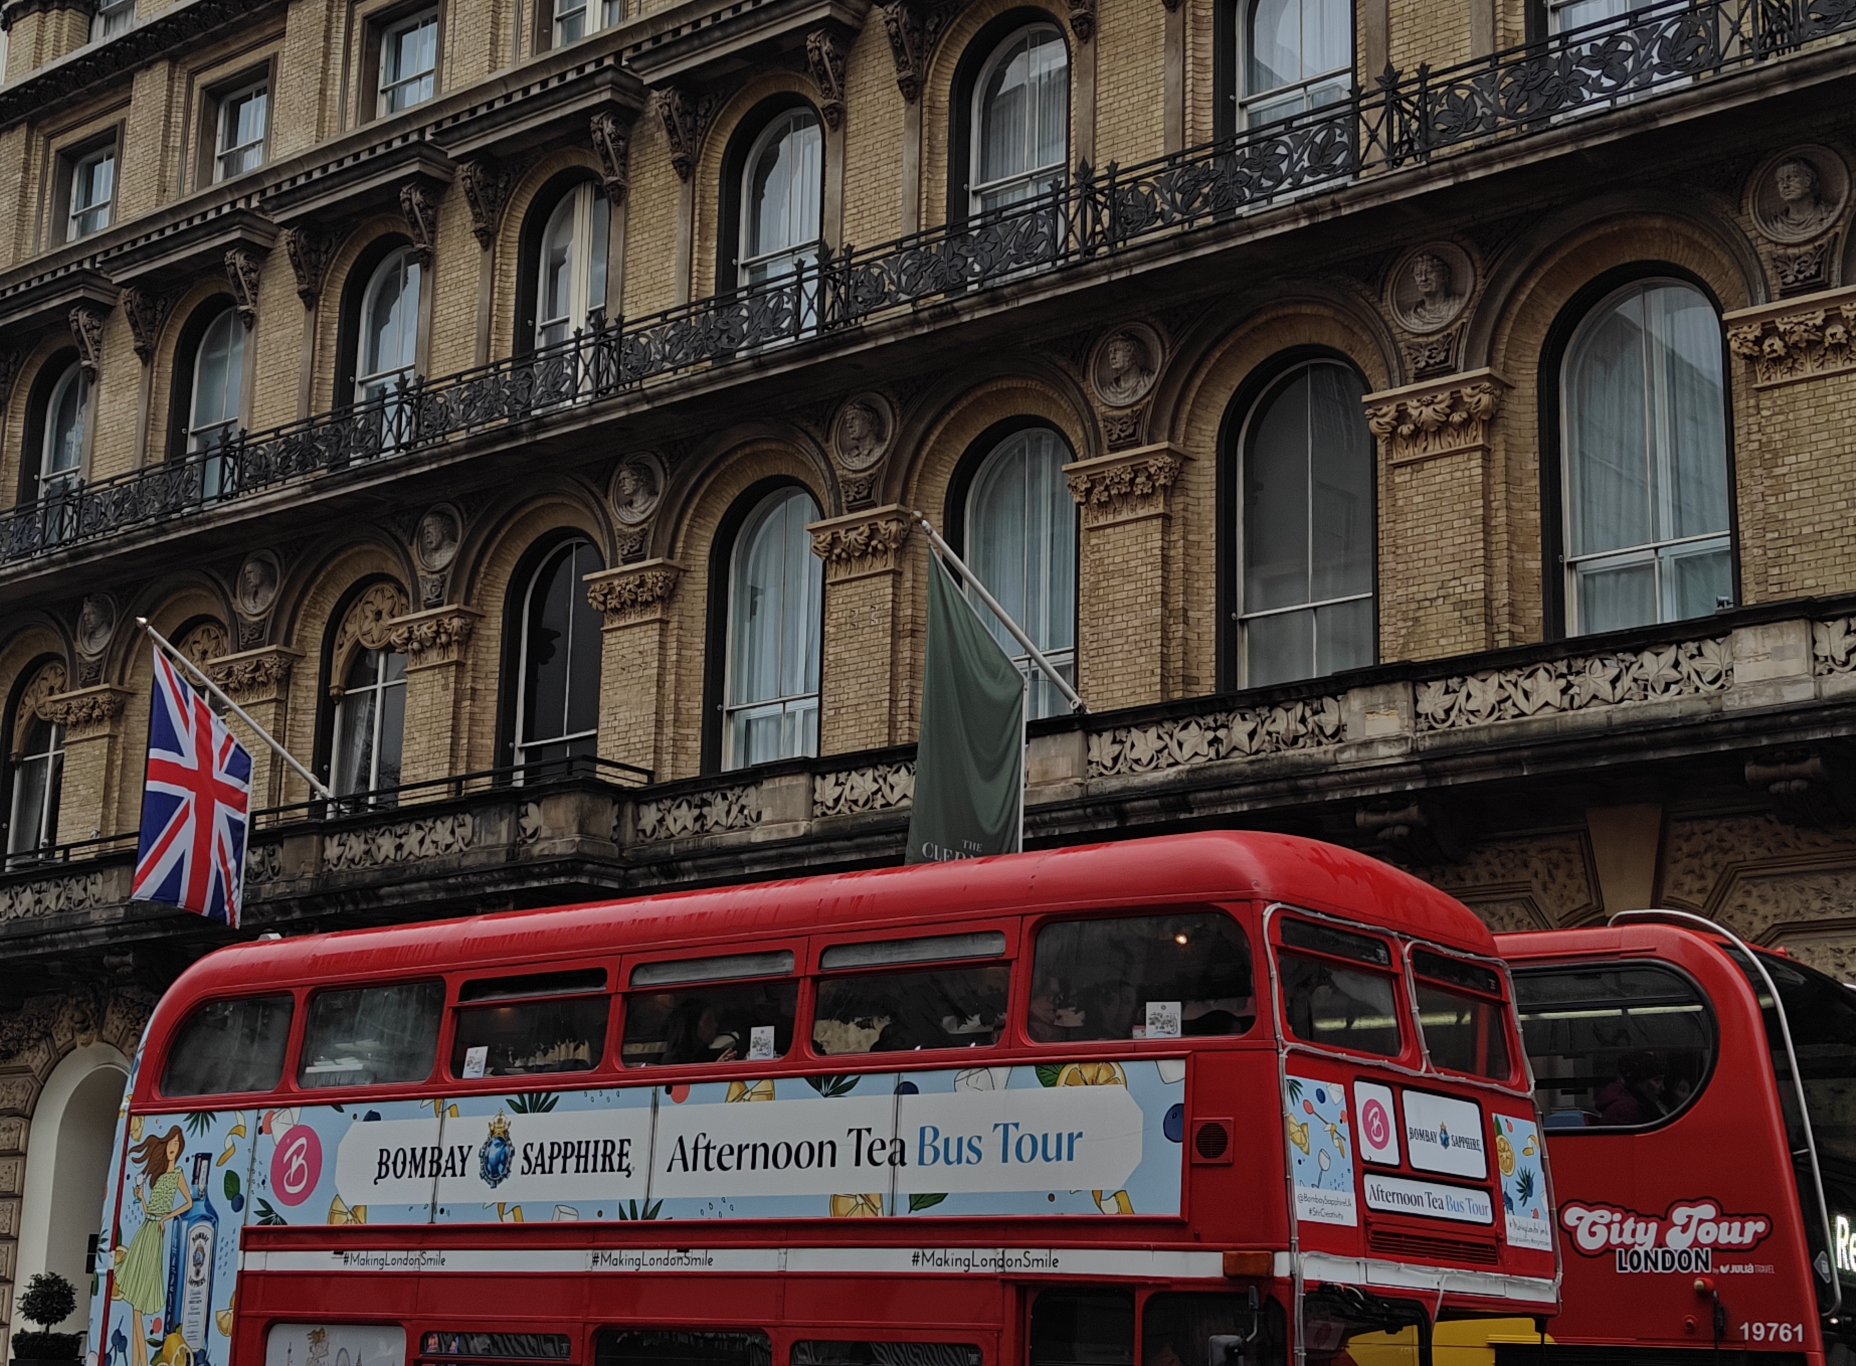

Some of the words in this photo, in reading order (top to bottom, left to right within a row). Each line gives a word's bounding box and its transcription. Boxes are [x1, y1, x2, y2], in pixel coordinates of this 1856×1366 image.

[962, 839, 982, 853] THE
[1409, 1126, 1438, 1144] BOMBAY
[1451, 1134, 1482, 1153] SAPPHIRE
[374, 1145, 473, 1185] BOMBAY
[521, 1139, 632, 1178] SAPPHIRE
[667, 1132, 837, 1173] Afternoon
[847, 1127, 907, 1167] Tea
[918, 1125, 983, 1167] Bus
[992, 1122, 1083, 1164] Tour
[1368, 1184, 1424, 1207] Afternoon
[1424, 1191, 1444, 1210] Tea
[1445, 1195, 1465, 1214] Bus
[1465, 1197, 1489, 1217] Tour
[1563, 1206, 1658, 1250] City
[1665, 1204, 1767, 1250] Tour
[343, 1251, 446, 1271] #MakingLondonSmile
[592, 1251, 714, 1271] #MakingLondonSmile
[912, 1249, 1059, 1272] #MakingLondonSmile
[1616, 1247, 1712, 1273] LONDON
[1739, 1322, 1804, 1343] 19761
